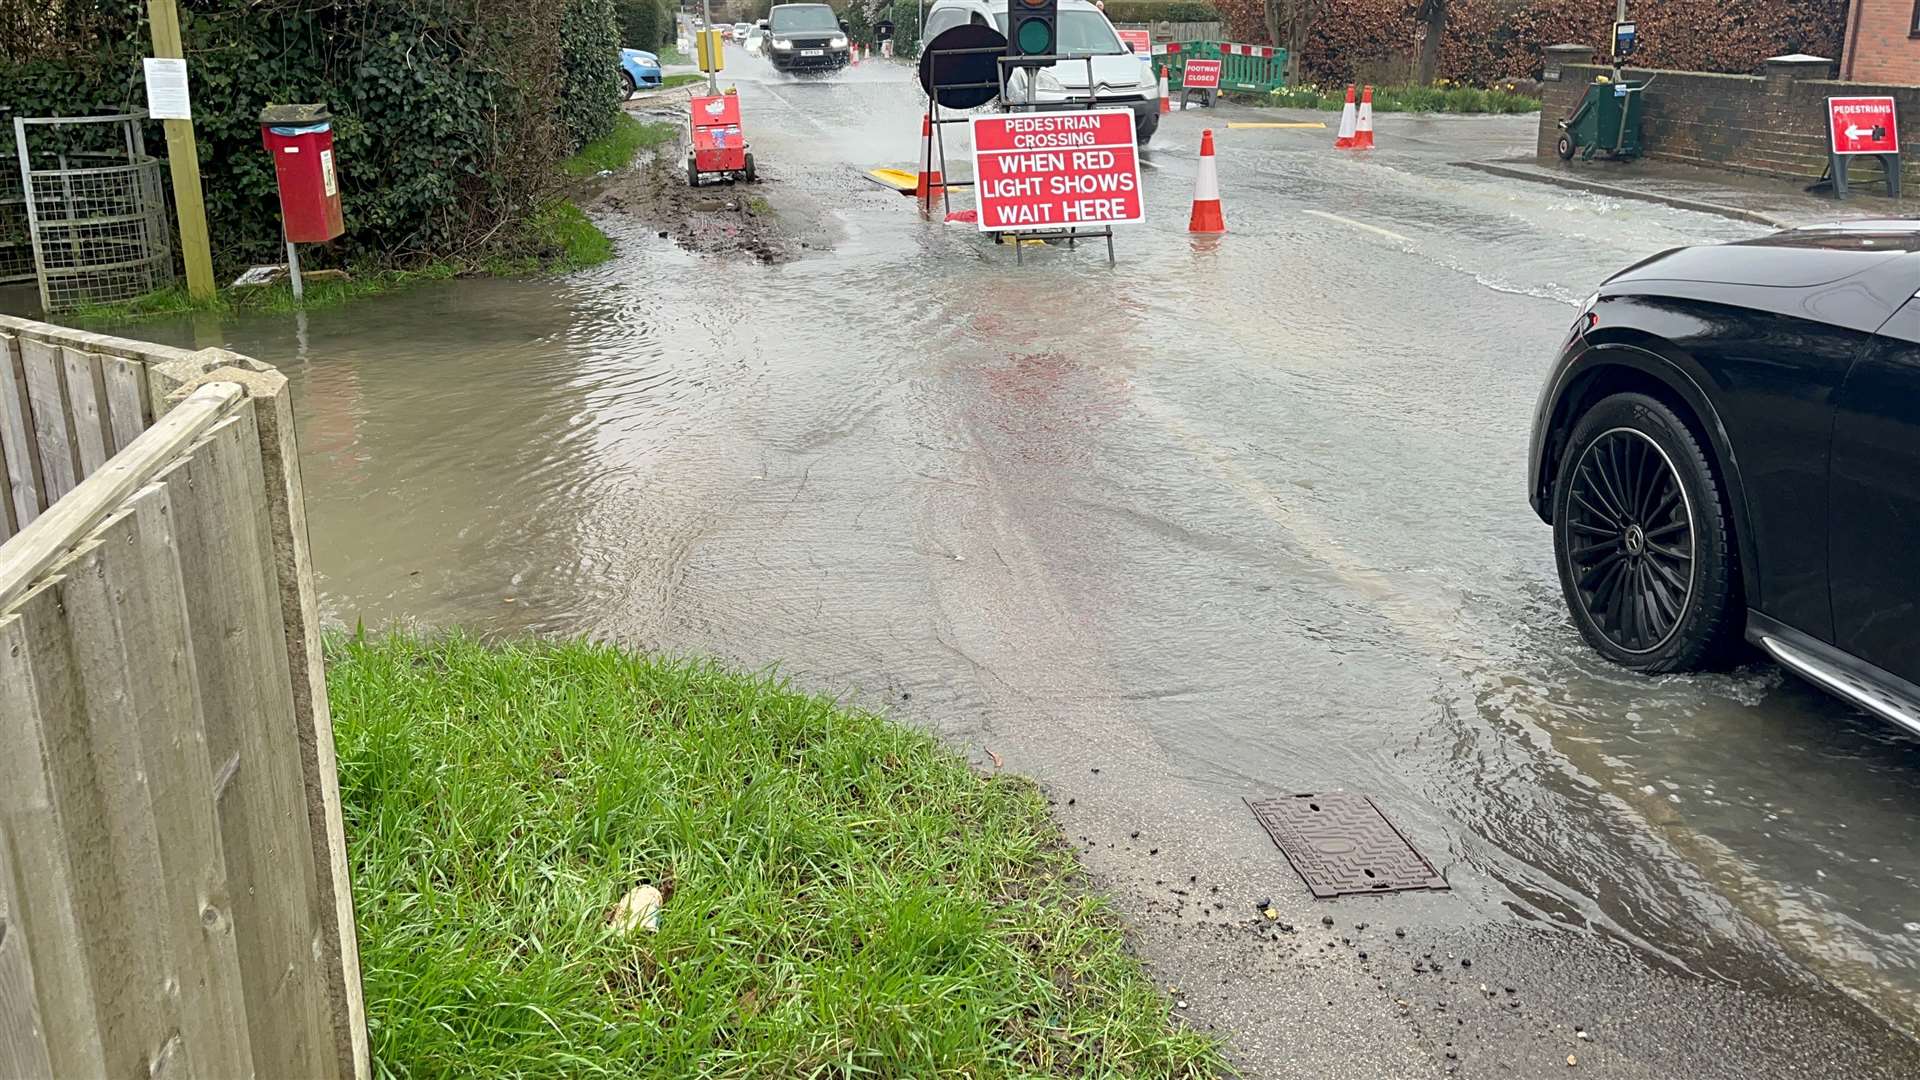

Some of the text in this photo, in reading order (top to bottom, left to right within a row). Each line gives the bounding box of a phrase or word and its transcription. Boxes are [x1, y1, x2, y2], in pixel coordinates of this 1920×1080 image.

[1833, 105, 1891, 114] PEDESTRIANS
[1005, 116, 1101, 132] PEDESTRIAN
[1014, 132, 1095, 148] CROSSING
[998, 151, 1115, 174] WHEN RED
[983, 172, 1134, 198] LIGHT SHOWS
[996, 198, 1128, 224] WAIT HERE
